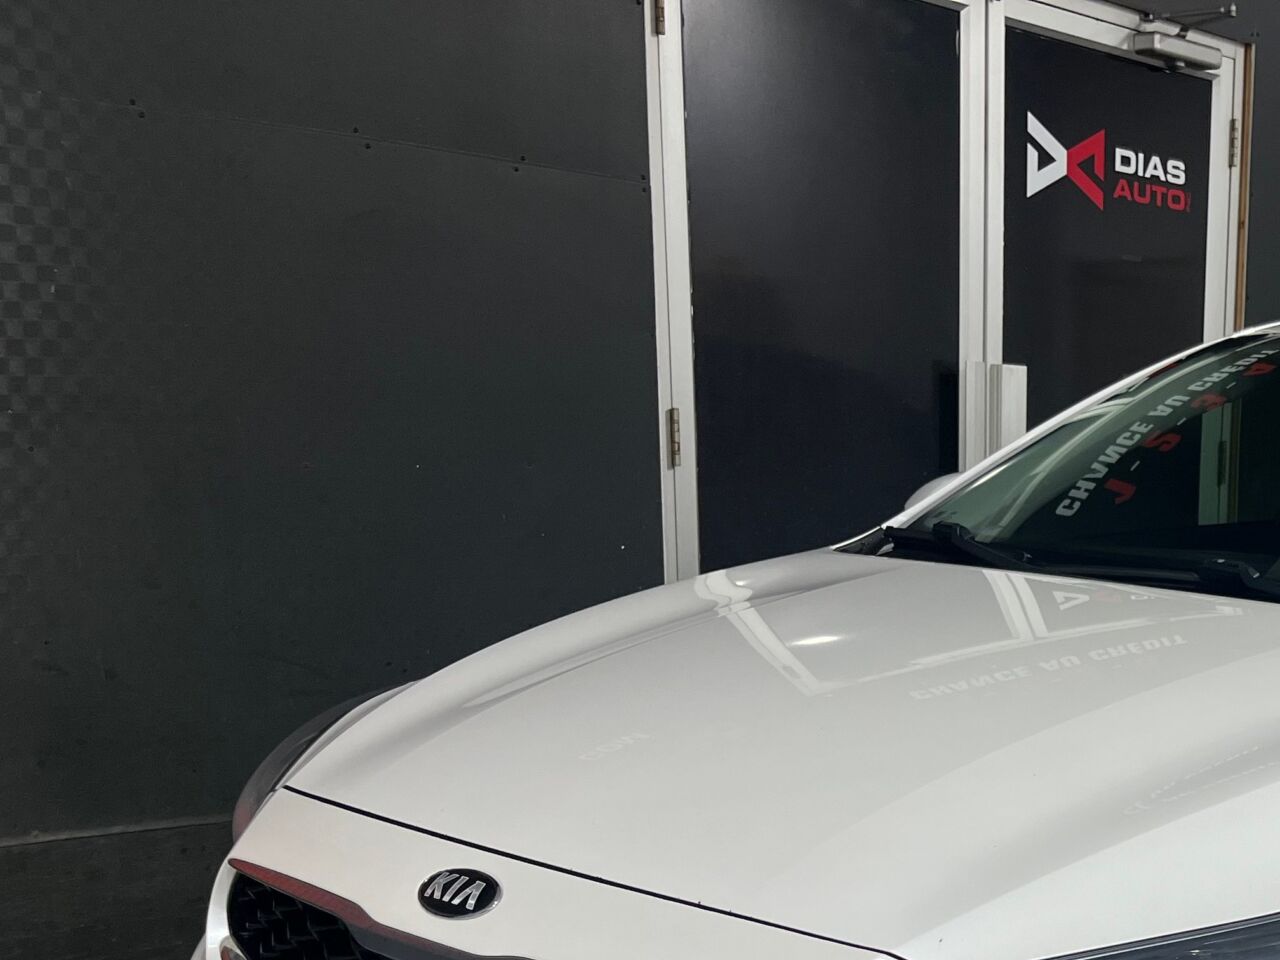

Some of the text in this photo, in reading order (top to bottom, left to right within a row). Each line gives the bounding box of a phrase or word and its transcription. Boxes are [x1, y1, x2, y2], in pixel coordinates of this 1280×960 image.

[1115, 147, 1186, 186] DIAS
[1113, 178, 1185, 212] AUTO
[423, 871, 487, 911] KIA
